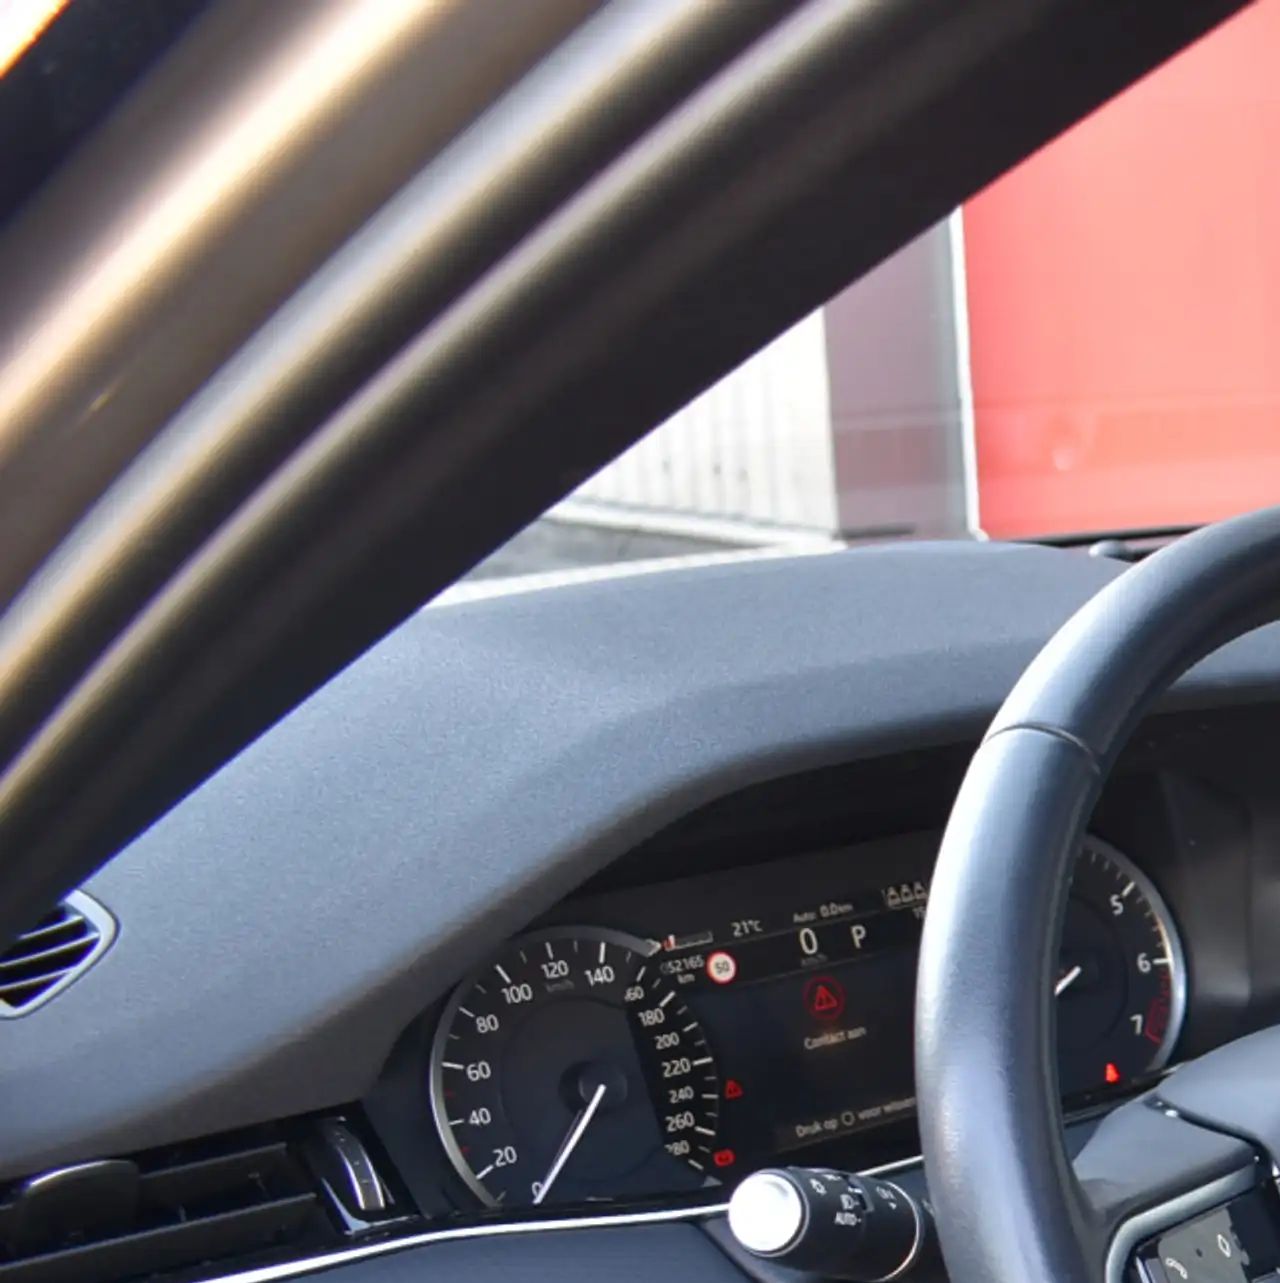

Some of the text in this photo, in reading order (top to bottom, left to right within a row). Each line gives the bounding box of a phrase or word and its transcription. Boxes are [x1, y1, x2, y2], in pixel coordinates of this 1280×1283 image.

[1110, 894, 1124, 915] 5
[800, 927, 818, 955] 0
[851, 924, 866, 948] P
[541, 960, 569, 980] 120
[714, 960, 731, 974] 50
[1136, 953, 1151, 973] 6
[585, 966, 615, 986] 140
[501, 983, 533, 1005] 100
[476, 1014, 499, 1033] 80
[638, 1007, 665, 1027] 180
[1130, 1014, 1143, 1035] 7
[654, 1032, 680, 1050] 200
[467, 1061, 491, 1081] 60
[662, 1058, 691, 1078] 220
[669, 1086, 694, 1103] 240
[468, 1108, 492, 1127] 40
[665, 1111, 695, 1132] 260
[493, 1146, 517, 1165] 20
[834, 1211, 858, 1226] AUTO
